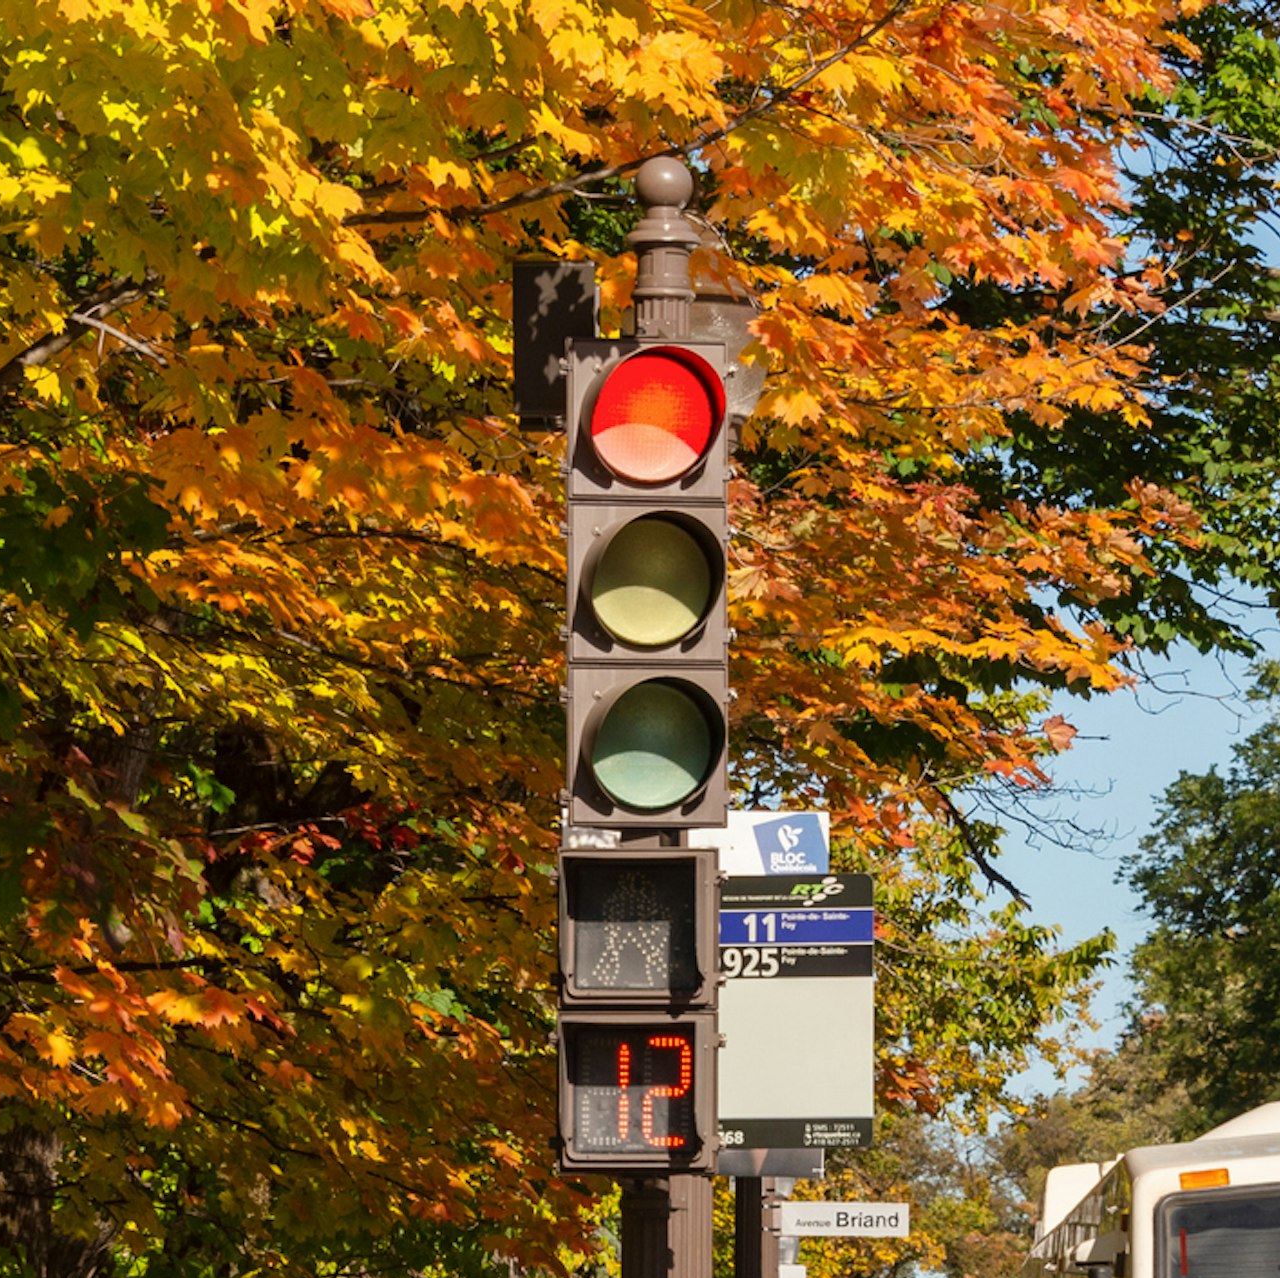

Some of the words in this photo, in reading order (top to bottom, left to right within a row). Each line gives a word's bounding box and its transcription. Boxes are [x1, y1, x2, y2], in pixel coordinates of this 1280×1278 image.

[770, 852, 806, 864] BLOC
[790, 883, 845, 895] RTC
[743, 912, 776, 942] 11
[722, 947, 780, 978] 925
[617, 1036, 692, 1148] 12
[795, 1219, 832, 1228] Avenue
[835, 1211, 900, 1228] Briand
